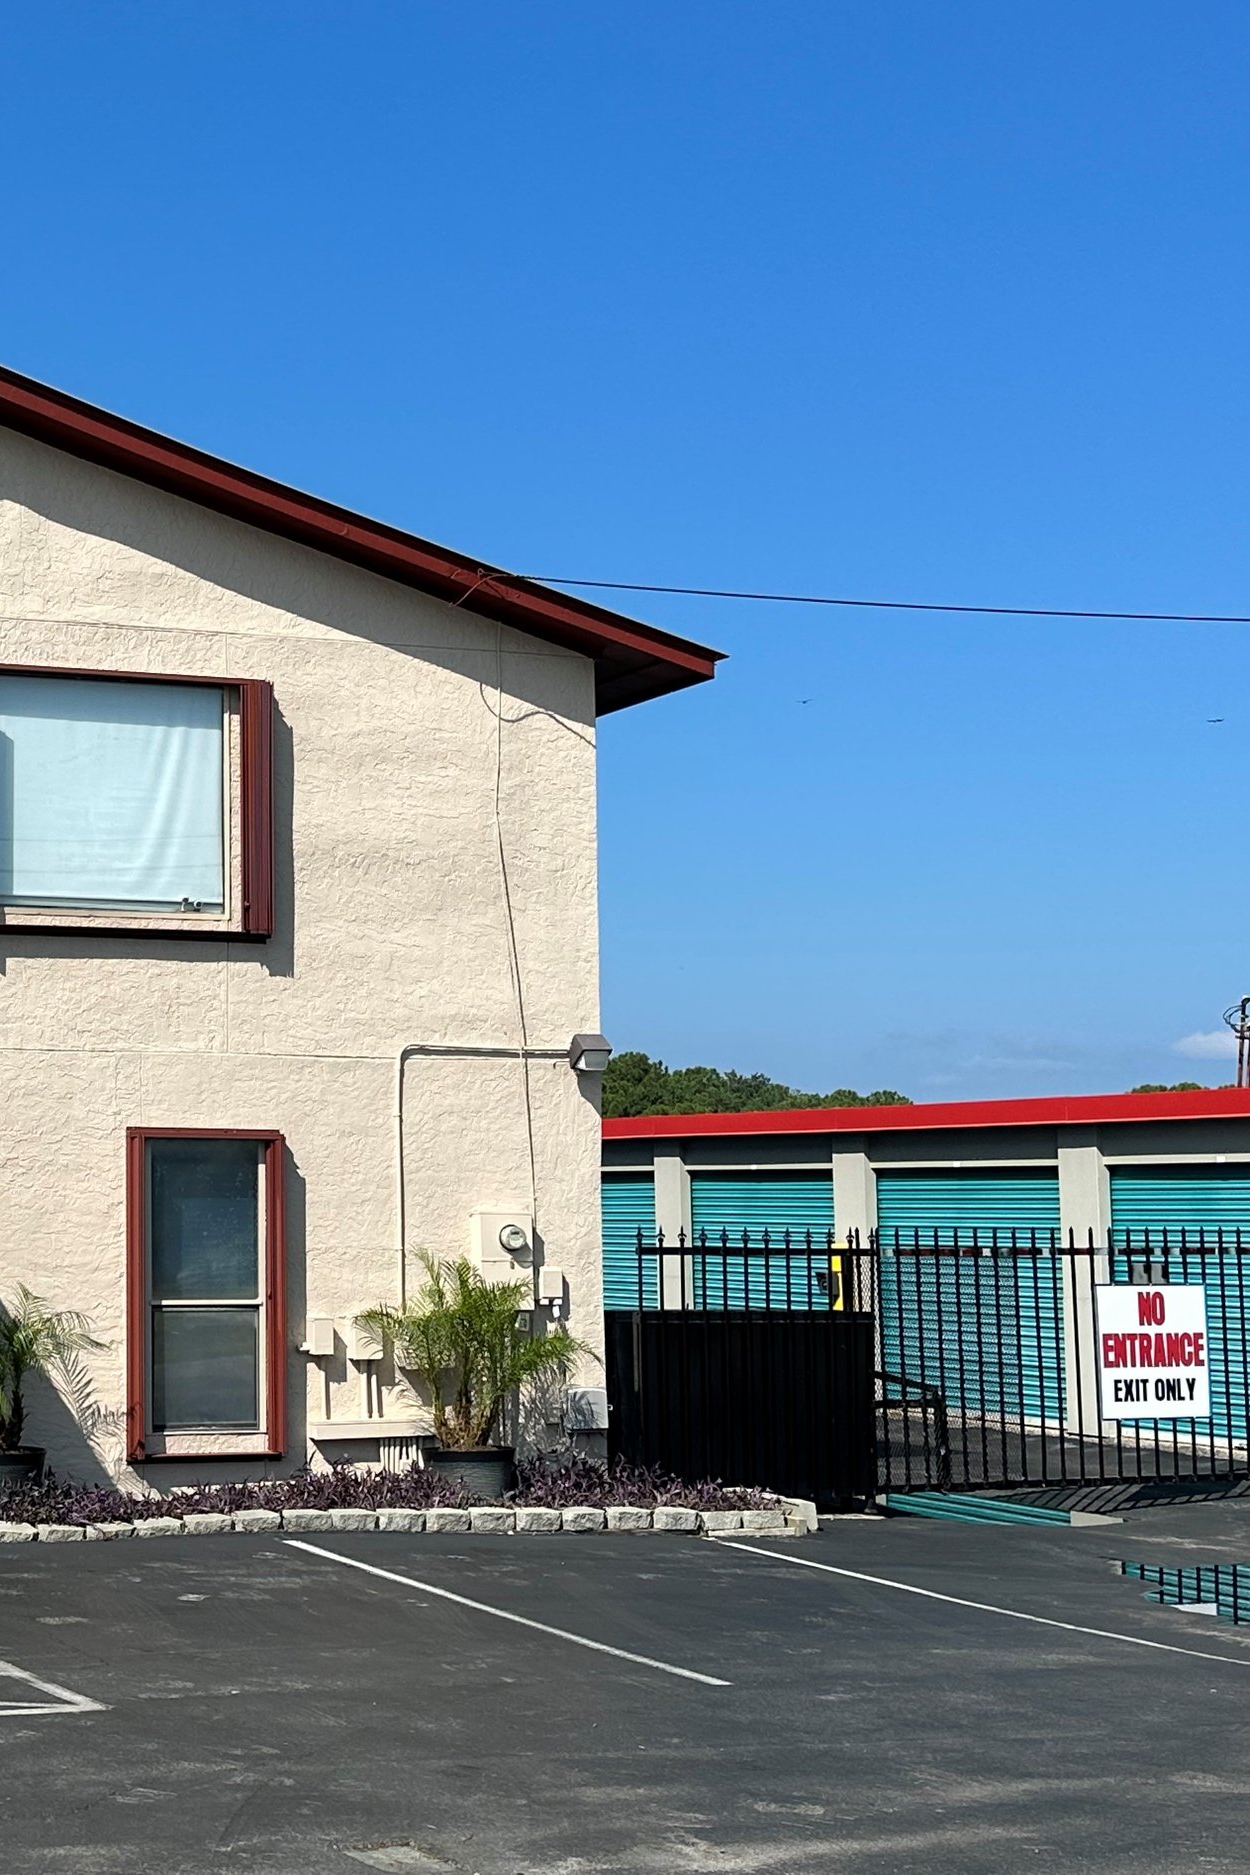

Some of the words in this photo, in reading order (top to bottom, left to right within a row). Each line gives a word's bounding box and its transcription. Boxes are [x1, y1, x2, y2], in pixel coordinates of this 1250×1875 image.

[1137, 1291, 1166, 1326] NO
[1102, 1332, 1205, 1368] ENTRANCE
[1114, 1379, 1149, 1402] EXIT
[1154, 1378, 1196, 1401] ONLY
